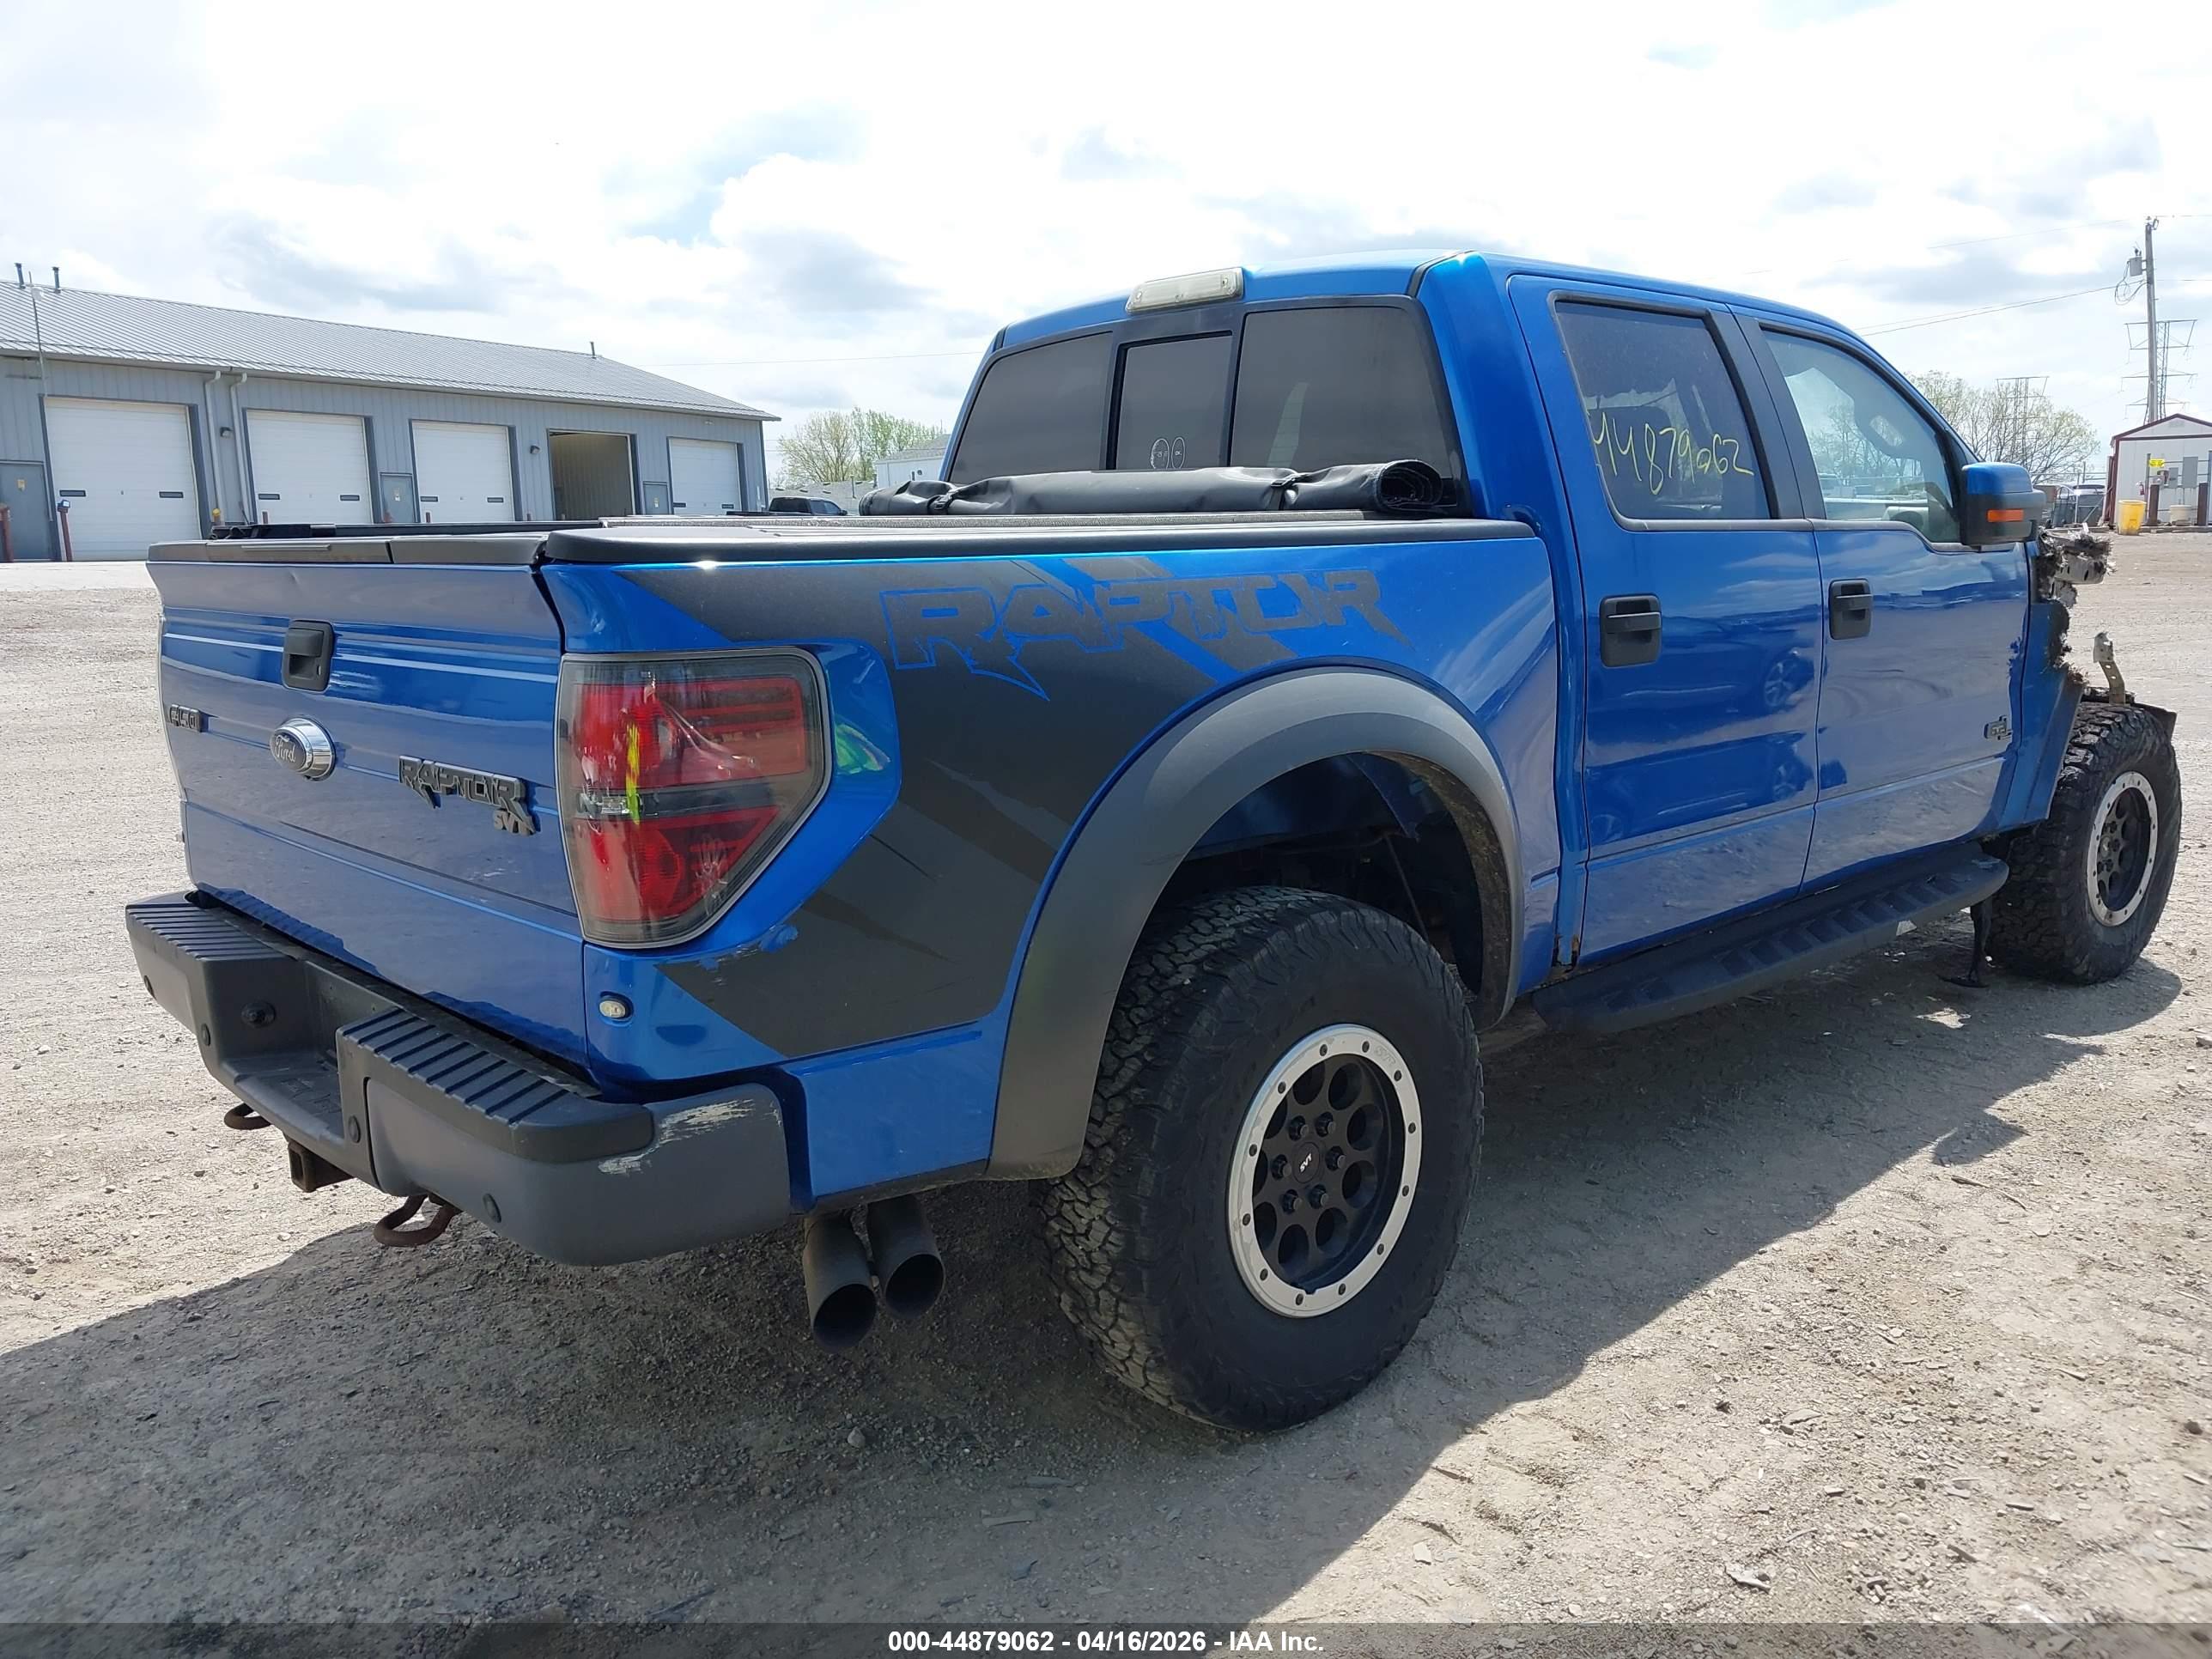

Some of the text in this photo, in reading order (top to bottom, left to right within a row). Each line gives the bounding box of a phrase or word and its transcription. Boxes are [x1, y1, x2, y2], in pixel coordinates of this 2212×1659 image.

[1592, 410, 1754, 495] 44879062
[879, 565, 1415, 702] RAPTOR
[398, 754, 536, 836] RAPTOR
[1299, 1151, 1313, 1173] SVT
